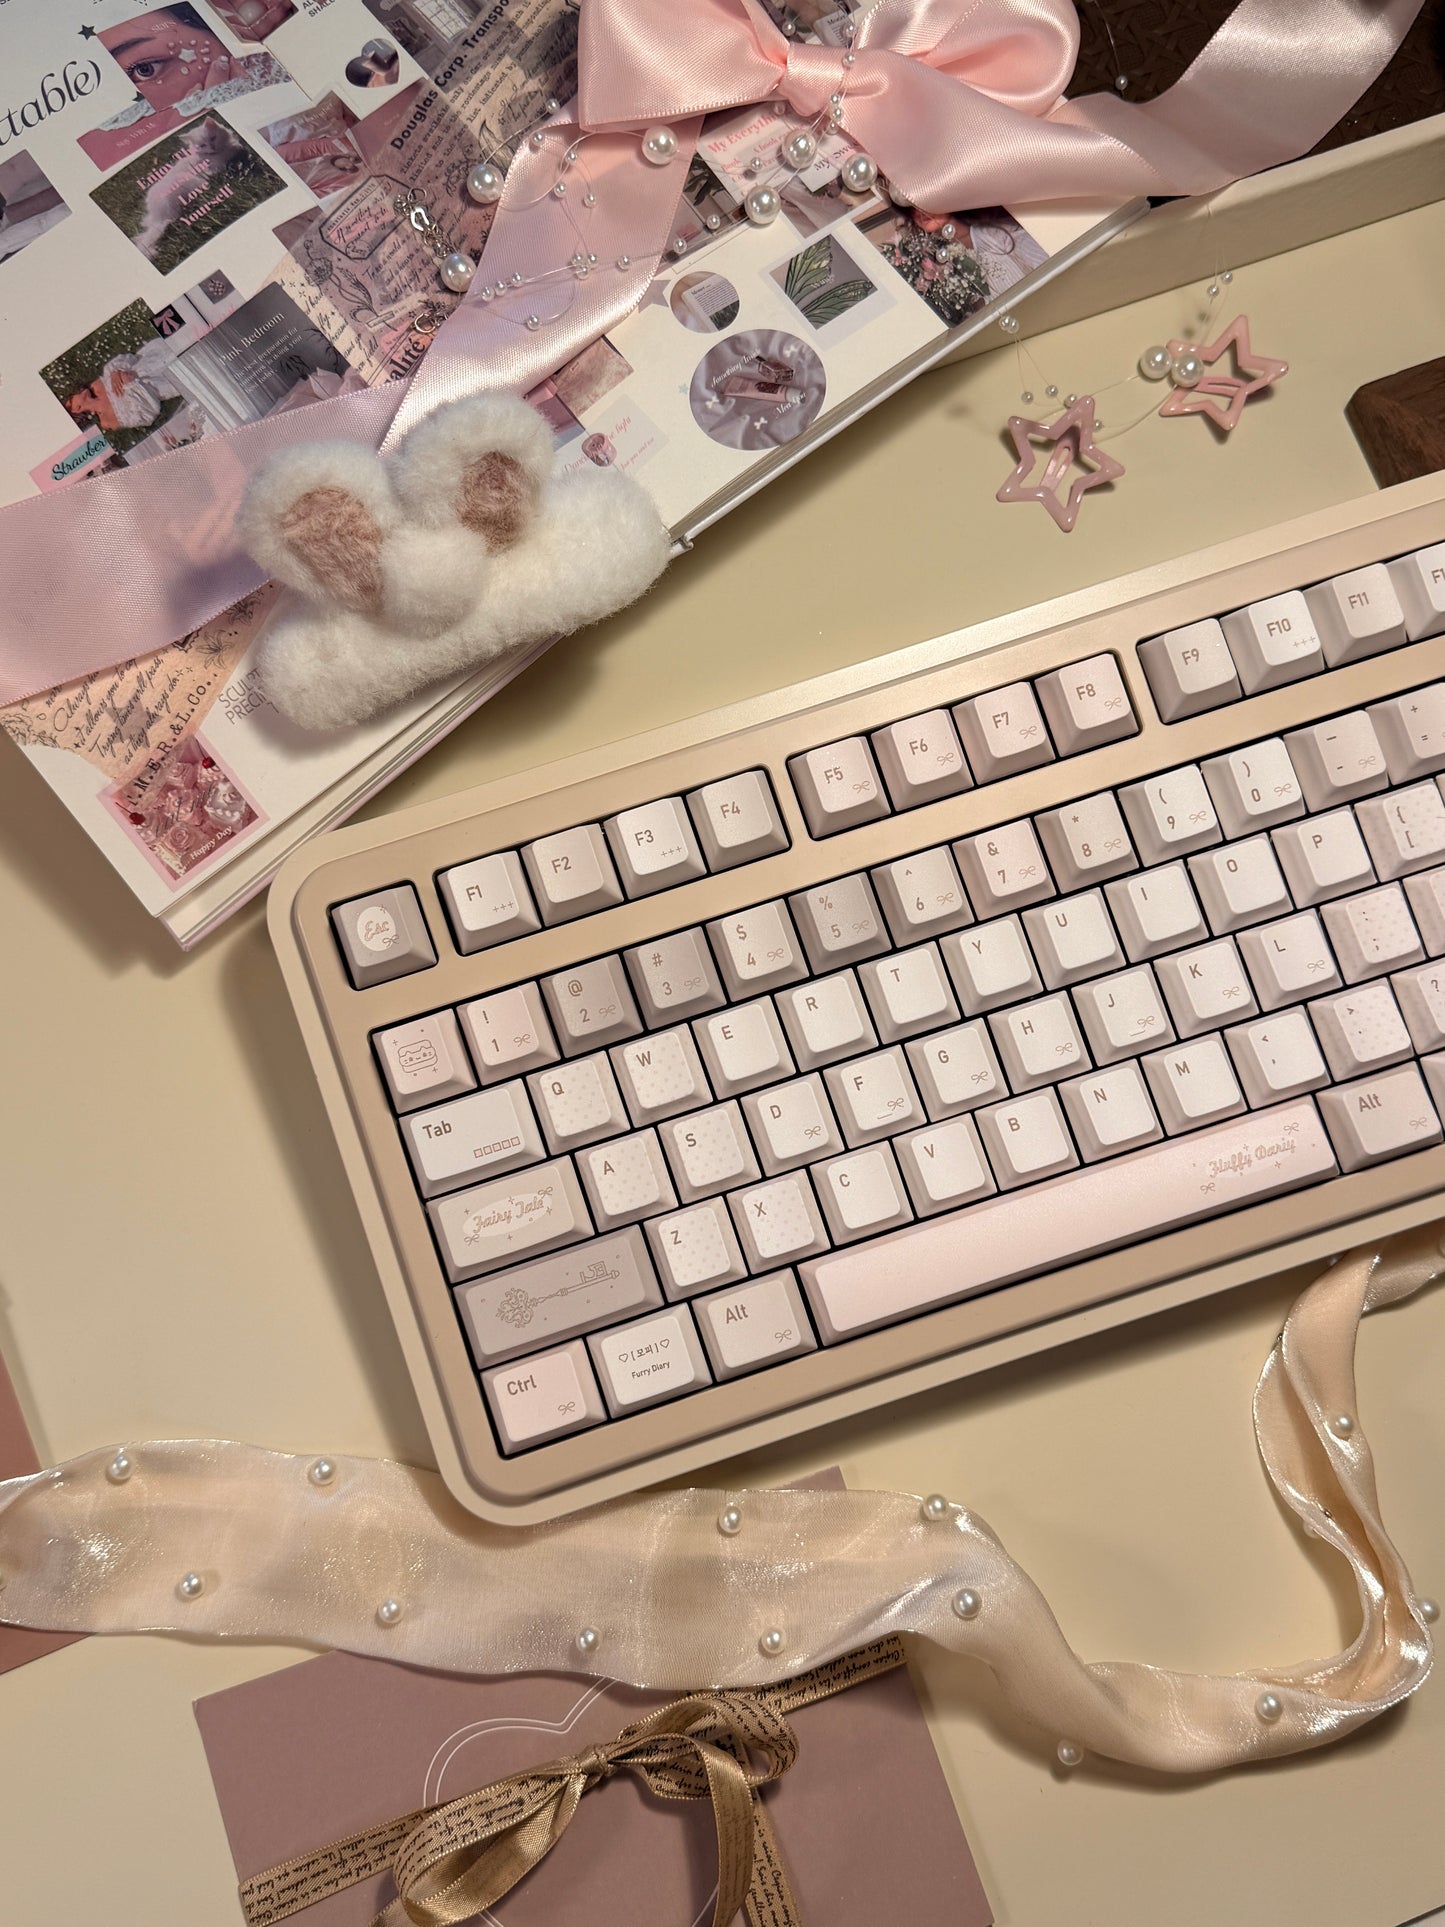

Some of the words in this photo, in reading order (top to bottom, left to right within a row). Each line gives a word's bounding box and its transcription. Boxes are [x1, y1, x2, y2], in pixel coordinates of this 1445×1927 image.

[0, 58, 101, 146] table)
[391, 90, 437, 149] Douglas
[434, 55, 466, 91] Corp.
[707, 139, 727, 154] My
[832, 139, 859, 158] Swe
[178, 181, 208, 205] Love
[180, 184, 233, 225] Yourself
[241, 313, 283, 347] Bedroom
[385, 338, 427, 382] alité
[51, 439, 107, 481] Strawber
[1347, 591, 1370, 610] F11
[1266, 618, 1292, 637] F10
[1181, 648, 1200, 666] F9
[1075, 683, 1097, 701] F8
[52, 681, 90, 731] Always
[81, 698, 111, 734] allows
[103, 681, 124, 710] you
[140, 689, 175, 730] always
[88, 726, 131, 757] Trying
[111, 700, 134, 725] times
[132, 672, 153, 702] will
[991, 711, 1011, 729] F7
[124, 727, 153, 755] they
[908, 738, 929, 756] F6
[124, 749, 133, 764] as
[823, 766, 845, 785] F5
[719, 801, 741, 819] F4
[1166, 815, 1177, 831] 9
[190, 837, 216, 861] Happy
[216, 825, 233, 842] Day
[634, 829, 655, 847] F3
[1311, 834, 1323, 849] P
[986, 842, 1000, 857] &
[1081, 842, 1092, 858] 8
[551, 856, 572, 874] F2
[1226, 859, 1238, 873] O
[997, 869, 1008, 885] 7
[465, 884, 483, 902] F1
[1140, 887, 1149, 901] I
[819, 895, 834, 911] %
[915, 897, 925, 912] 6
[1054, 913, 1069, 928] U
[735, 923, 747, 942] $
[830, 925, 842, 939] 5
[971, 941, 984, 955] Y
[1273, 939, 1287, 953] L
[652, 952, 663, 968] #
[746, 952, 757, 967] 4
[889, 968, 901, 984] T
[1188, 963, 1203, 979] K
[567, 979, 583, 998] @
[662, 980, 673, 996] 3
[1430, 978, 1440, 993] ?
[805, 996, 819, 1012] R
[1107, 993, 1116, 1009] J
[482, 1010, 490, 1025] !
[579, 1008, 591, 1025] 2
[721, 1025, 734, 1041] E
[1020, 1020, 1035, 1036] H
[491, 1038, 501, 1053] 1
[635, 1050, 653, 1068] W
[938, 1050, 950, 1065] G
[1174, 1061, 1191, 1077] M
[550, 1081, 565, 1096] Q
[853, 1076, 865, 1091] F
[1093, 1088, 1108, 1103] N
[1357, 1092, 1383, 1113] Alt
[769, 1104, 782, 1120] D
[422, 1120, 453, 1140] Tab
[1007, 1117, 1022, 1133] B
[684, 1132, 698, 1148] S
[923, 1144, 936, 1160] V
[602, 1160, 616, 1176] A
[838, 1173, 851, 1188] C
[472, 1206, 513, 1235] Fairy
[514, 1197, 545, 1219] Tale
[753, 1201, 768, 1218] X
[670, 1229, 683, 1246] Z
[723, 1305, 749, 1325] Alt
[636, 1344, 654, 1360] 모피
[631, 1366, 652, 1380] Furry
[651, 1359, 671, 1375] Diary
[506, 1374, 538, 1397] Ctrl
